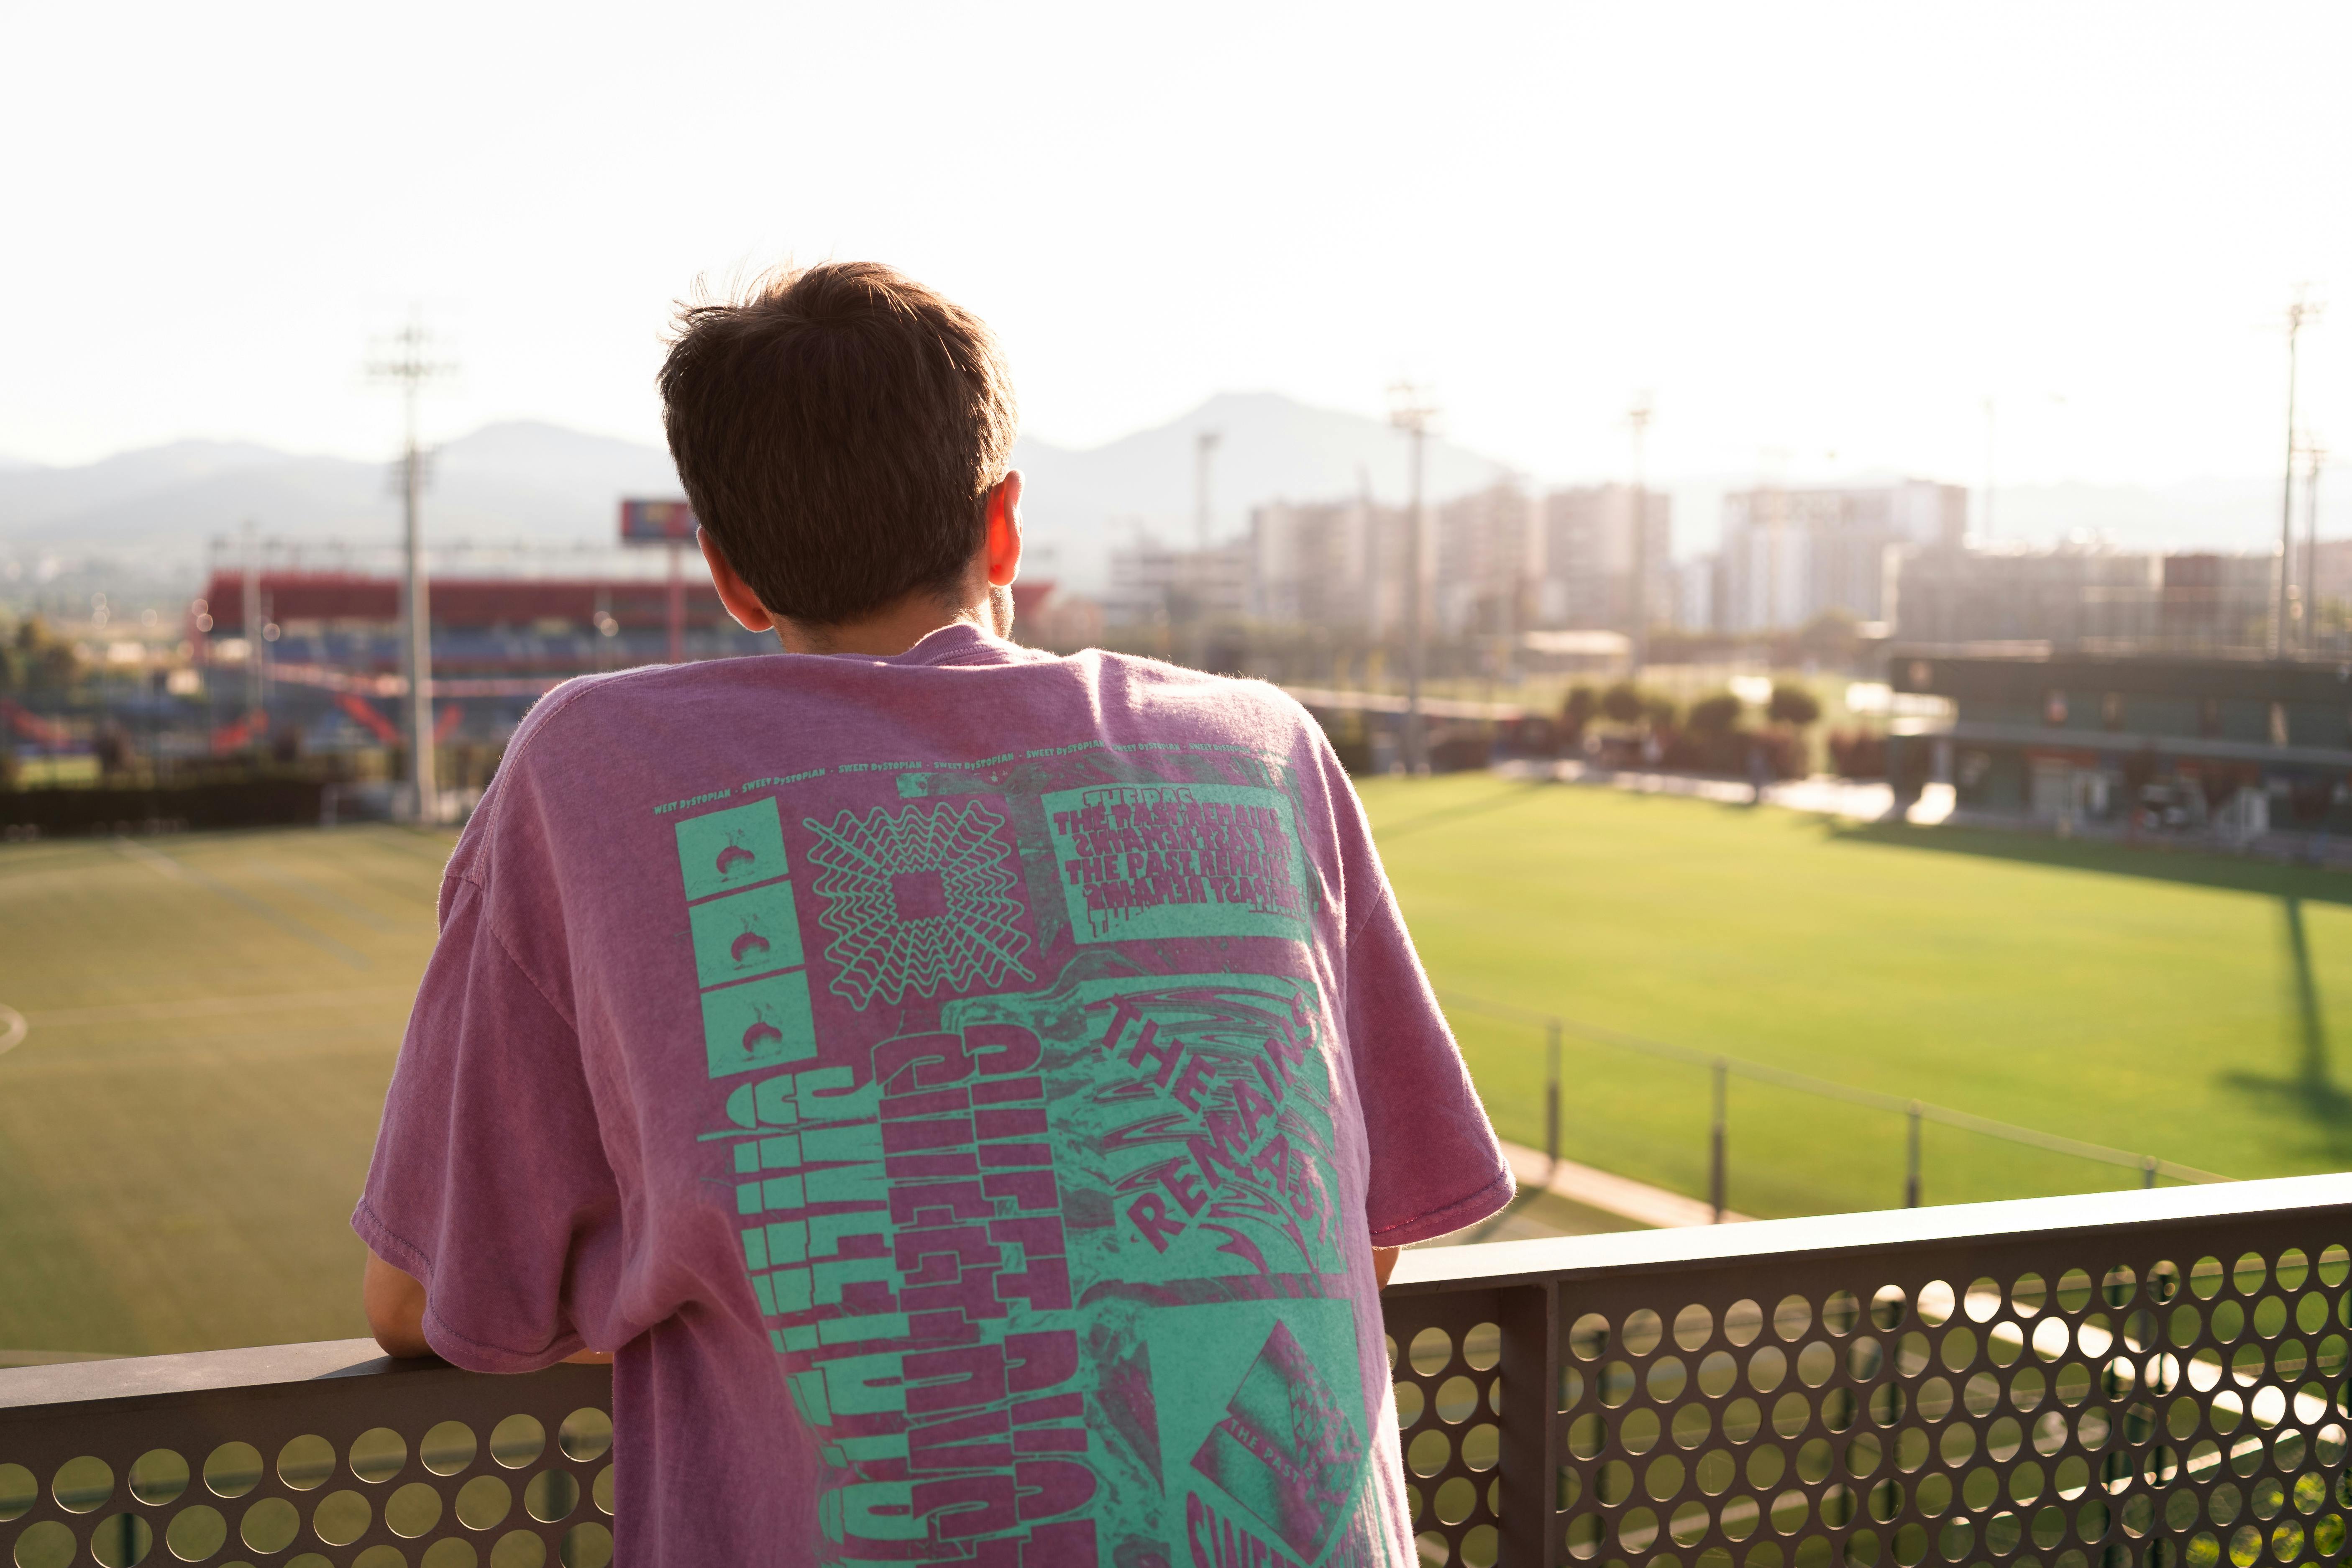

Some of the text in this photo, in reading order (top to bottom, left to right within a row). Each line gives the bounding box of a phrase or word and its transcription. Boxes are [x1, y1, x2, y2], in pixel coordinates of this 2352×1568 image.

[742, 778, 771, 793] SWEET
[839, 763, 868, 773] SWEET
[1026, 749, 1054, 758] SWEET
[1189, 742, 1212, 751] SWEET
[1054, 803, 1107, 835] THE
[1065, 849, 1290, 885] THE PAST REMAINS
[1101, 993, 1217, 1114] THE
[1231, 1418, 1258, 1449] THE
[1263, 1446, 1300, 1484] PAST
